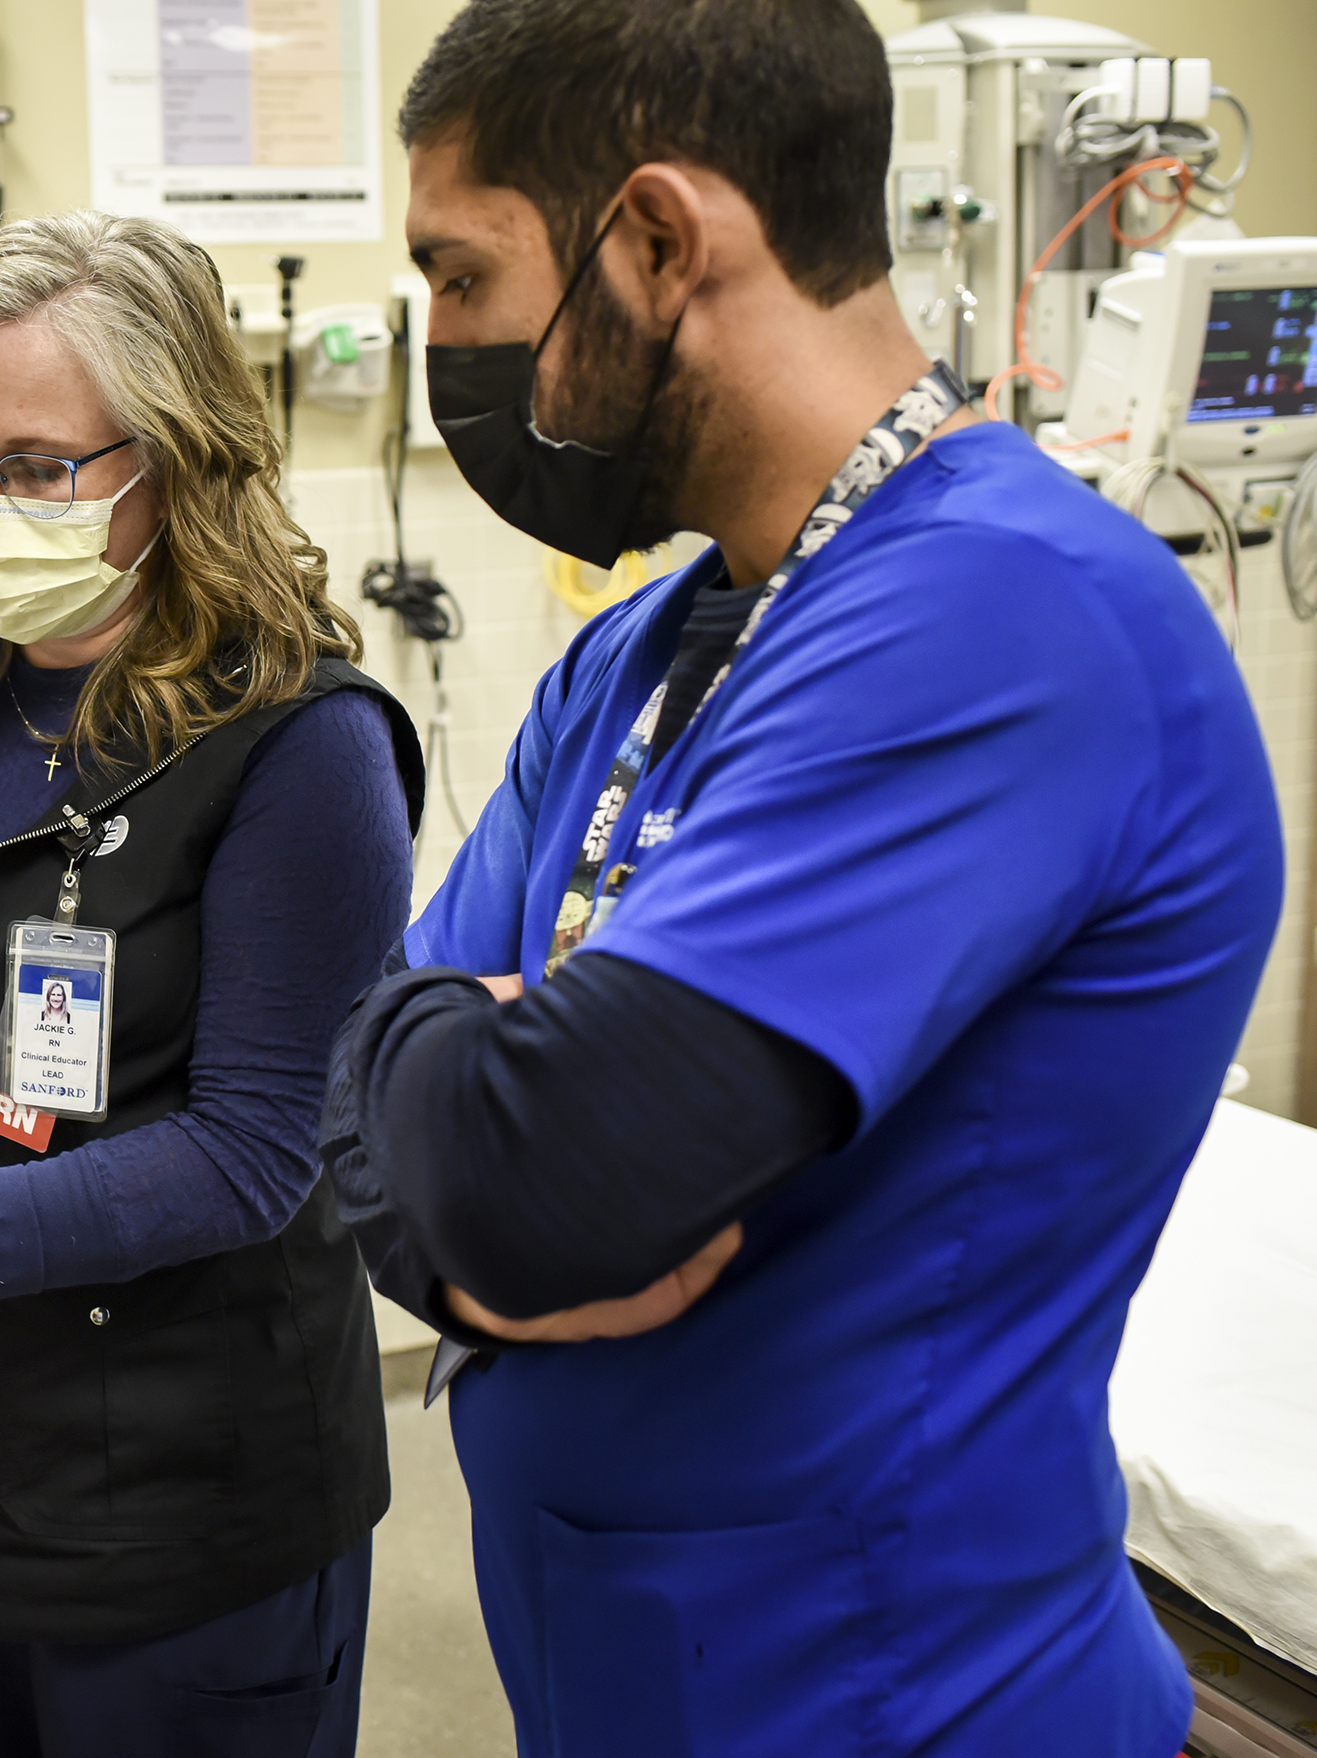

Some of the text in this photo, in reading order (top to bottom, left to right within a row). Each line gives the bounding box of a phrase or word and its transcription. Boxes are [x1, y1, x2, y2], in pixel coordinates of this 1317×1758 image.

[582, 785, 617, 851] STAR
[34, 1024, 76, 1036] JACKIE G.
[48, 1039, 60, 1048] RN
[21, 1052, 87, 1066] Clinical Educator
[42, 1070, 64, 1080] LEAD
